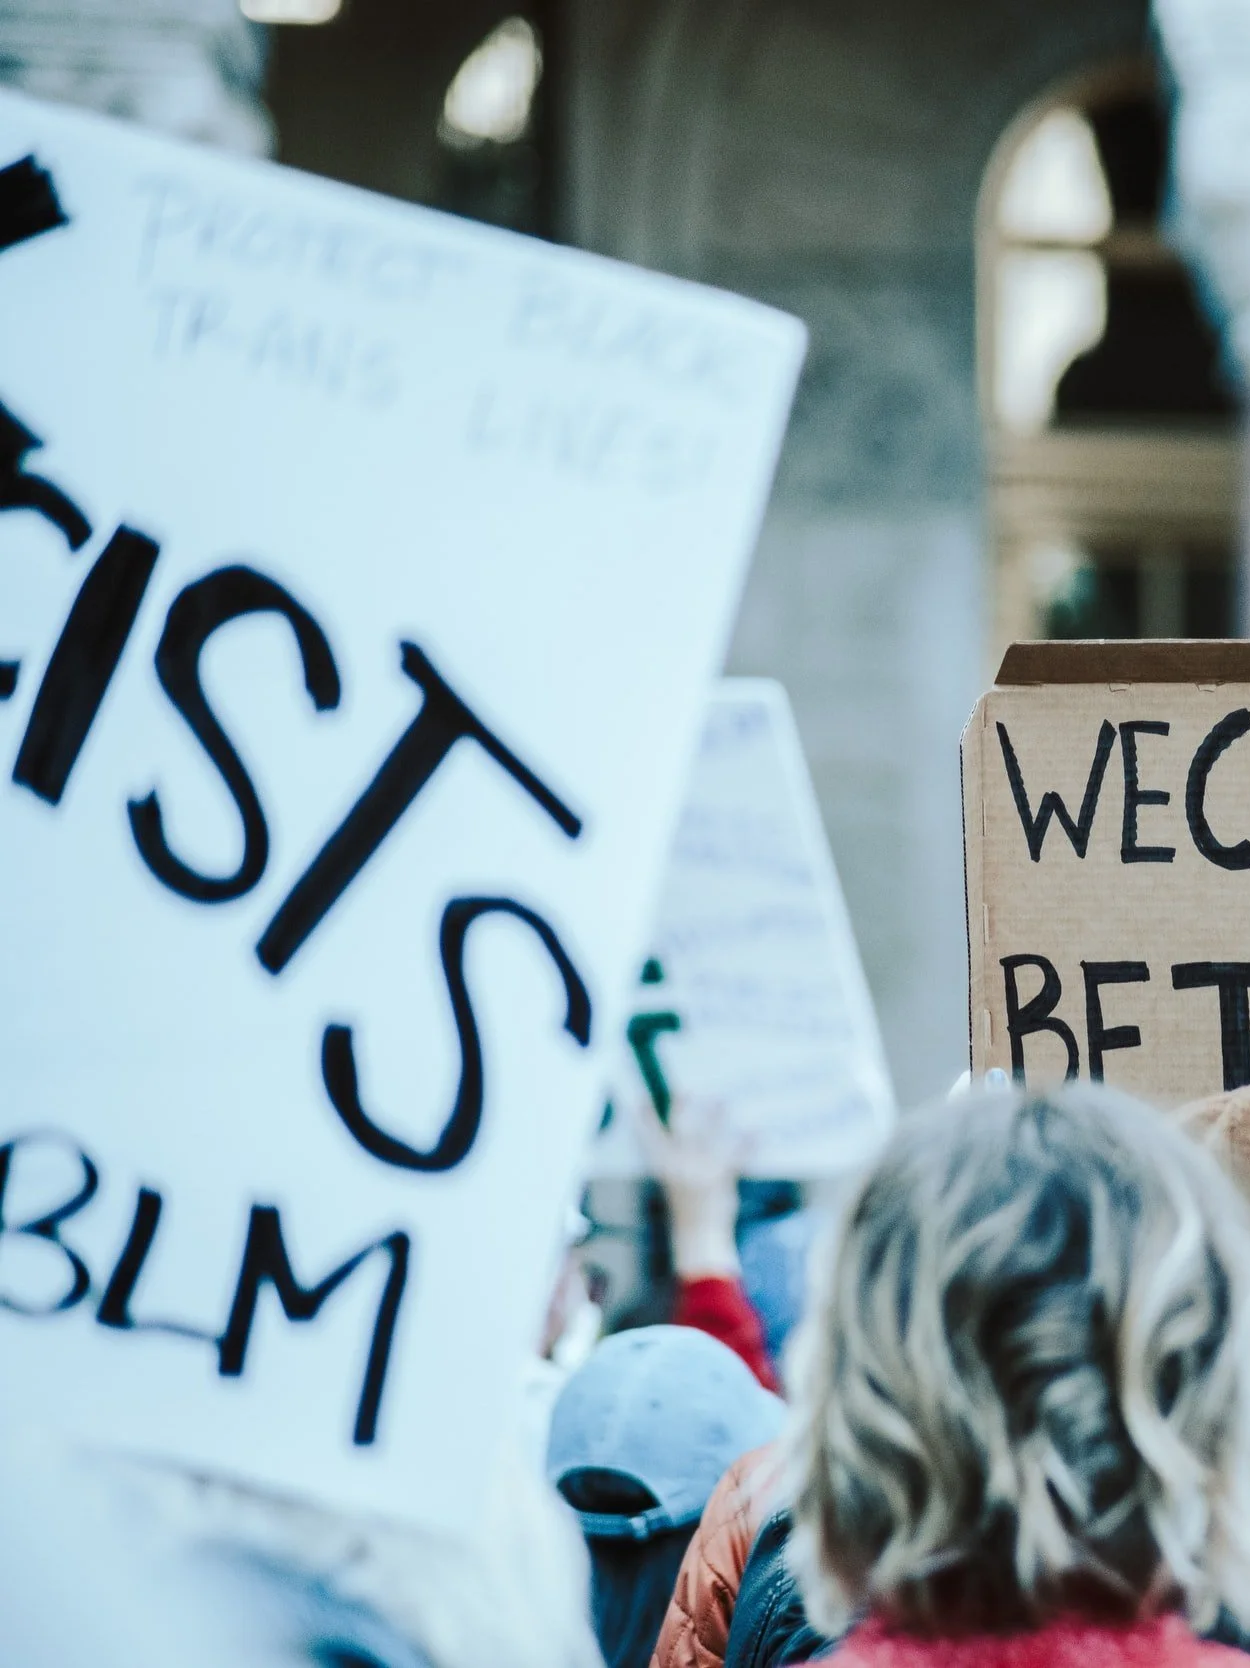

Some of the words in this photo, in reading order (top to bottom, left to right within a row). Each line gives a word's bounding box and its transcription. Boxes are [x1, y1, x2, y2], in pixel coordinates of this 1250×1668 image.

[131, 171, 474, 307] PROTECT
[145, 284, 405, 416] TRANS
[0, 1130, 410, 1445] BLM
